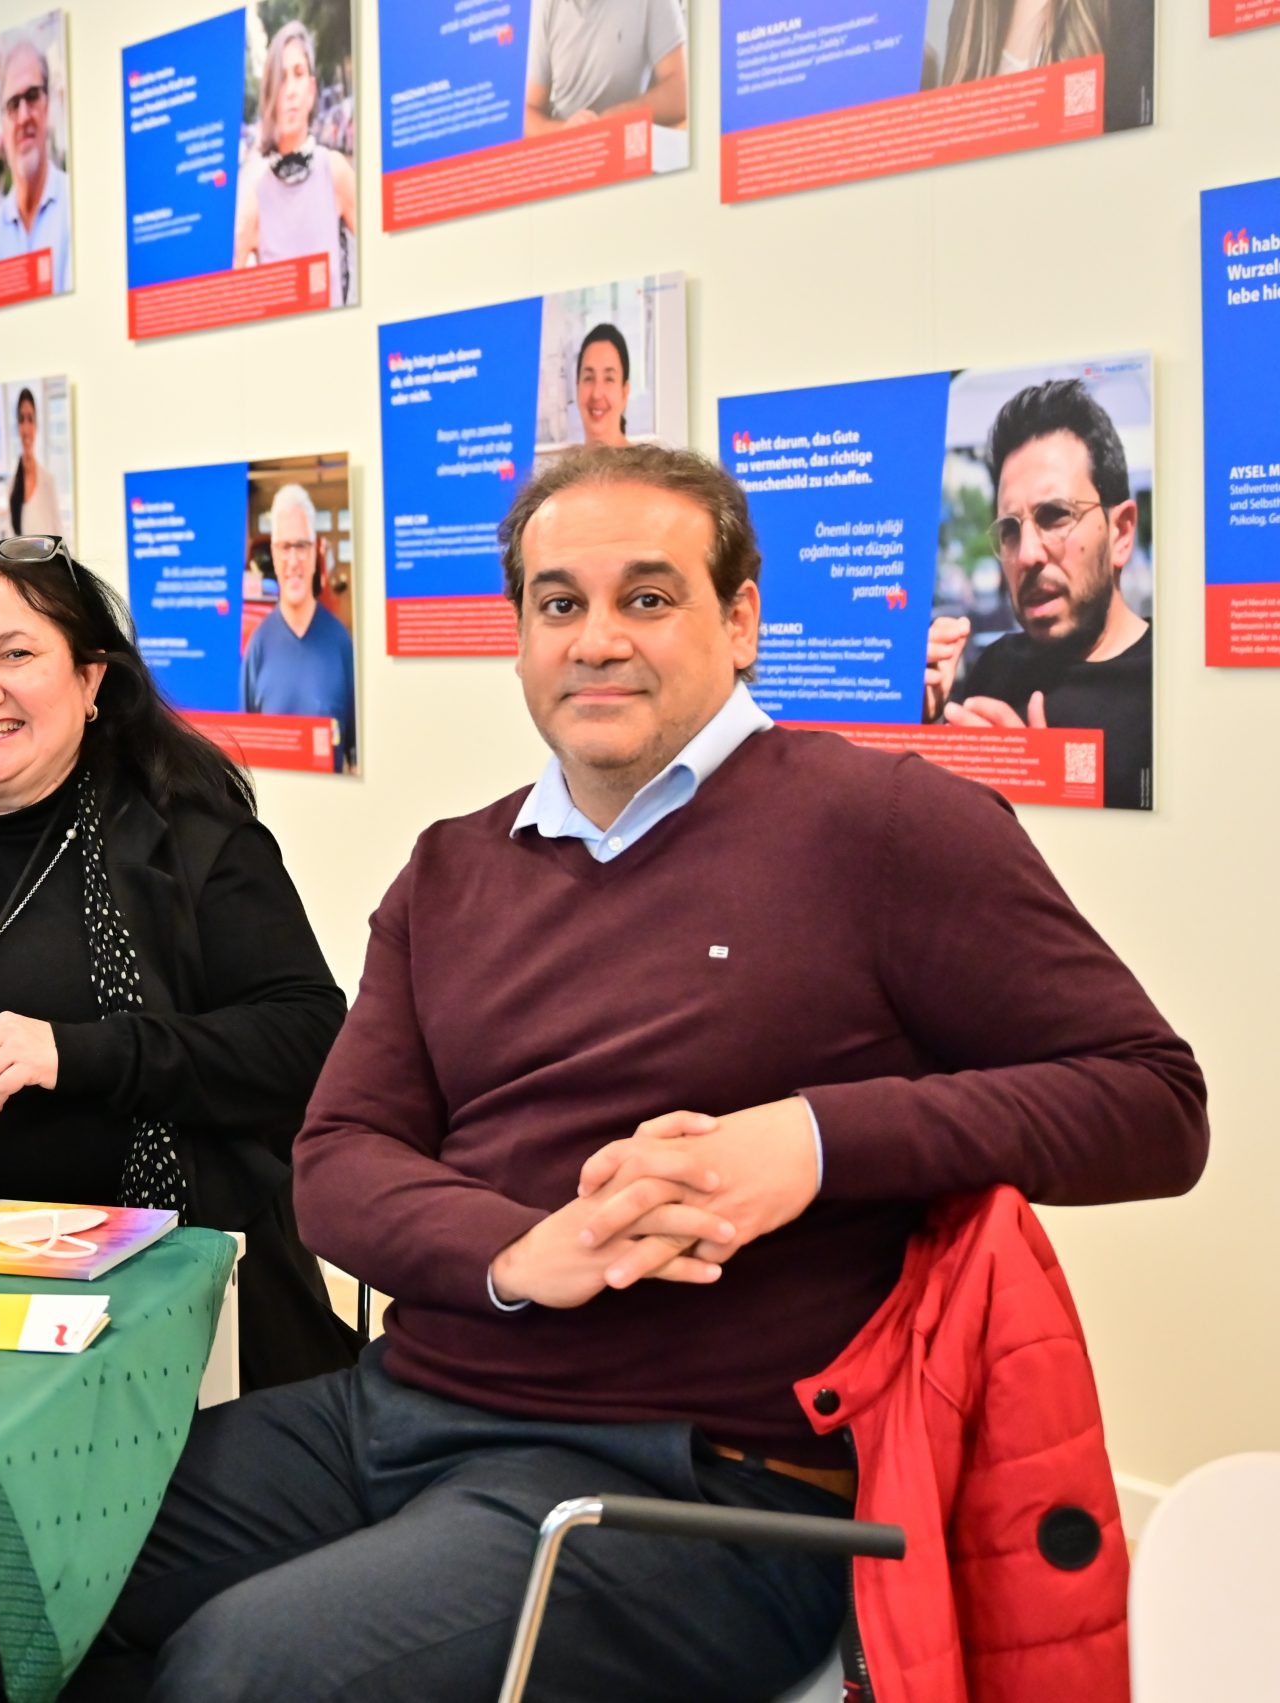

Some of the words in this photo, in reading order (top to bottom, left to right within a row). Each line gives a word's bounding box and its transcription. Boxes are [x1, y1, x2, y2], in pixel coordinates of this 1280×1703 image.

[1227, 239, 1249, 257] Ich
[1227, 257, 1280, 281] Wurzel
[1227, 287, 1260, 306] lebe
[735, 438, 749, 453] Es
[749, 437, 772, 455] geht
[773, 435, 811, 450] darum,
[812, 432, 831, 447] das
[833, 429, 860, 445] Gute
[736, 461, 748, 473] zu
[749, 456, 808, 473] vermehren,
[810, 452, 829, 468] das
[830, 449, 873, 467] richtige
[809, 475, 822, 488] zu
[824, 470, 873, 487] schaffen.
[1229, 464, 1267, 480] AYSEL
[1230, 498, 1248, 511] und
[815, 519, 851, 537] Önemli
[852, 521, 874, 536] olan
[852, 546, 863, 556] ve
[864, 541, 903, 559] düzgün
[831, 563, 845, 578] bir
[845, 563, 872, 577] insan
[873, 560, 904, 579] profili
